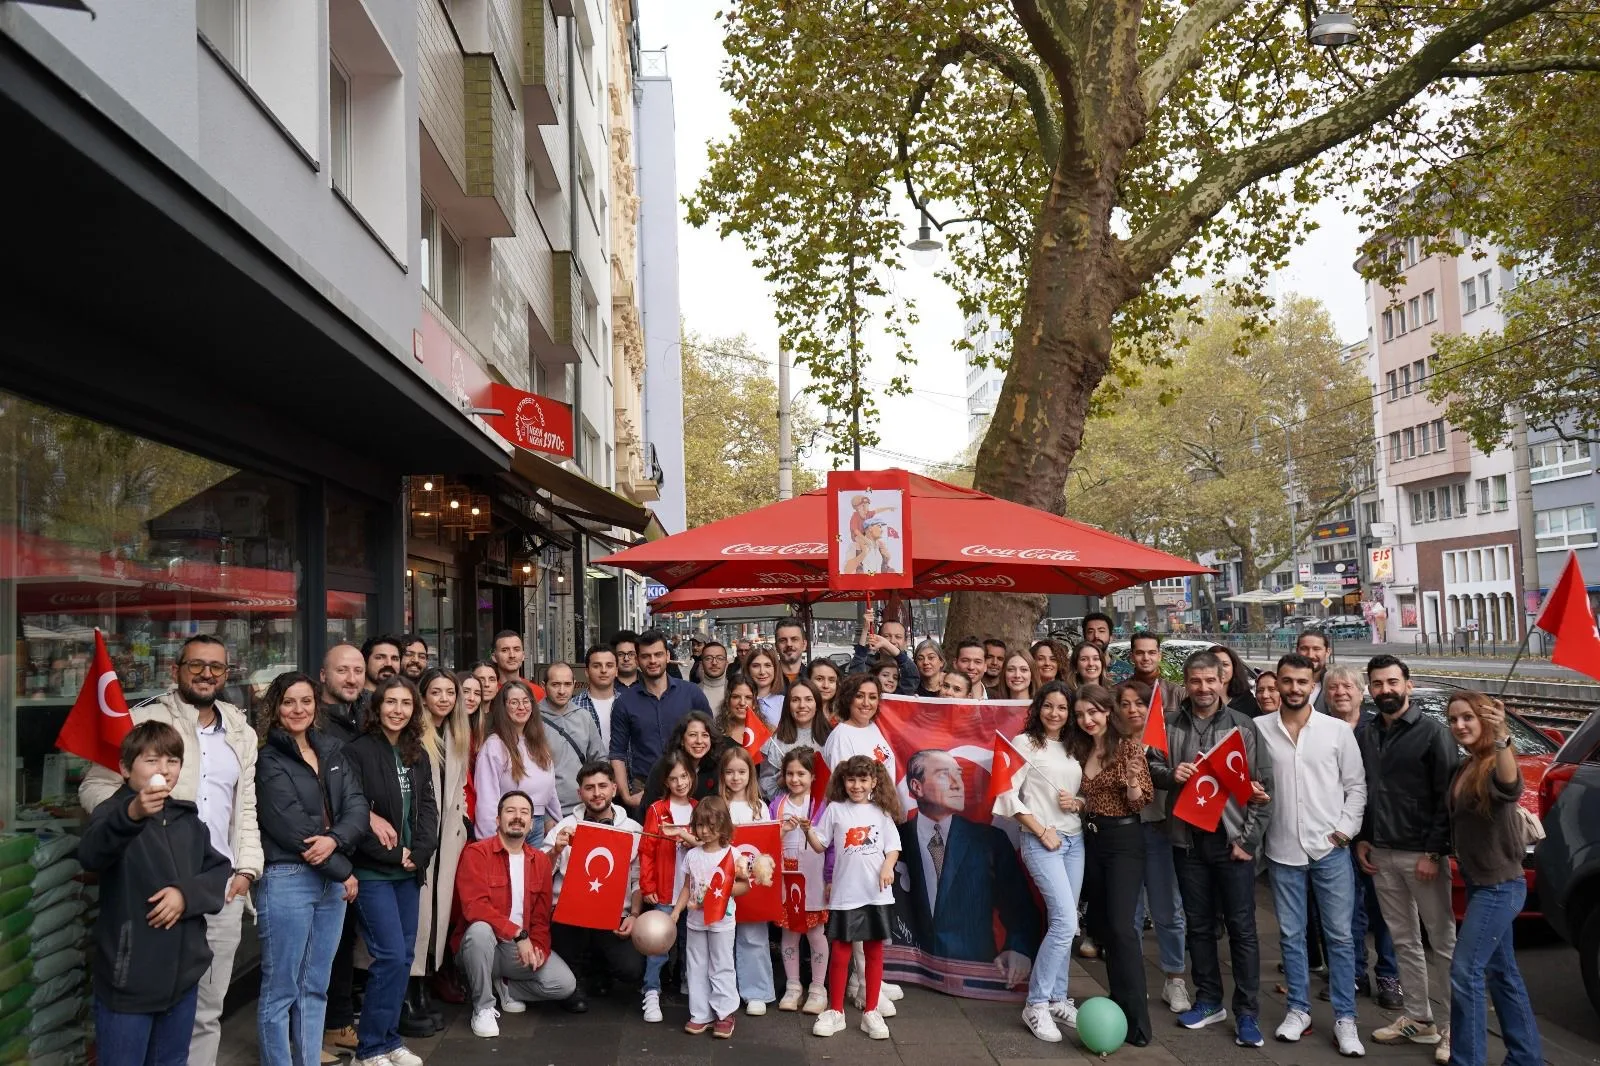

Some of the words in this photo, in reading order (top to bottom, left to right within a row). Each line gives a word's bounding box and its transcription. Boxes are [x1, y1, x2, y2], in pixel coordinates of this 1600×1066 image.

[517, 398, 535, 412] STREET
[535, 403, 546, 427] FOOD
[543, 432, 565, 451] 1970s
[960, 544, 1081, 562] Coca-Cola
[1372, 549, 1391, 562] EIS
